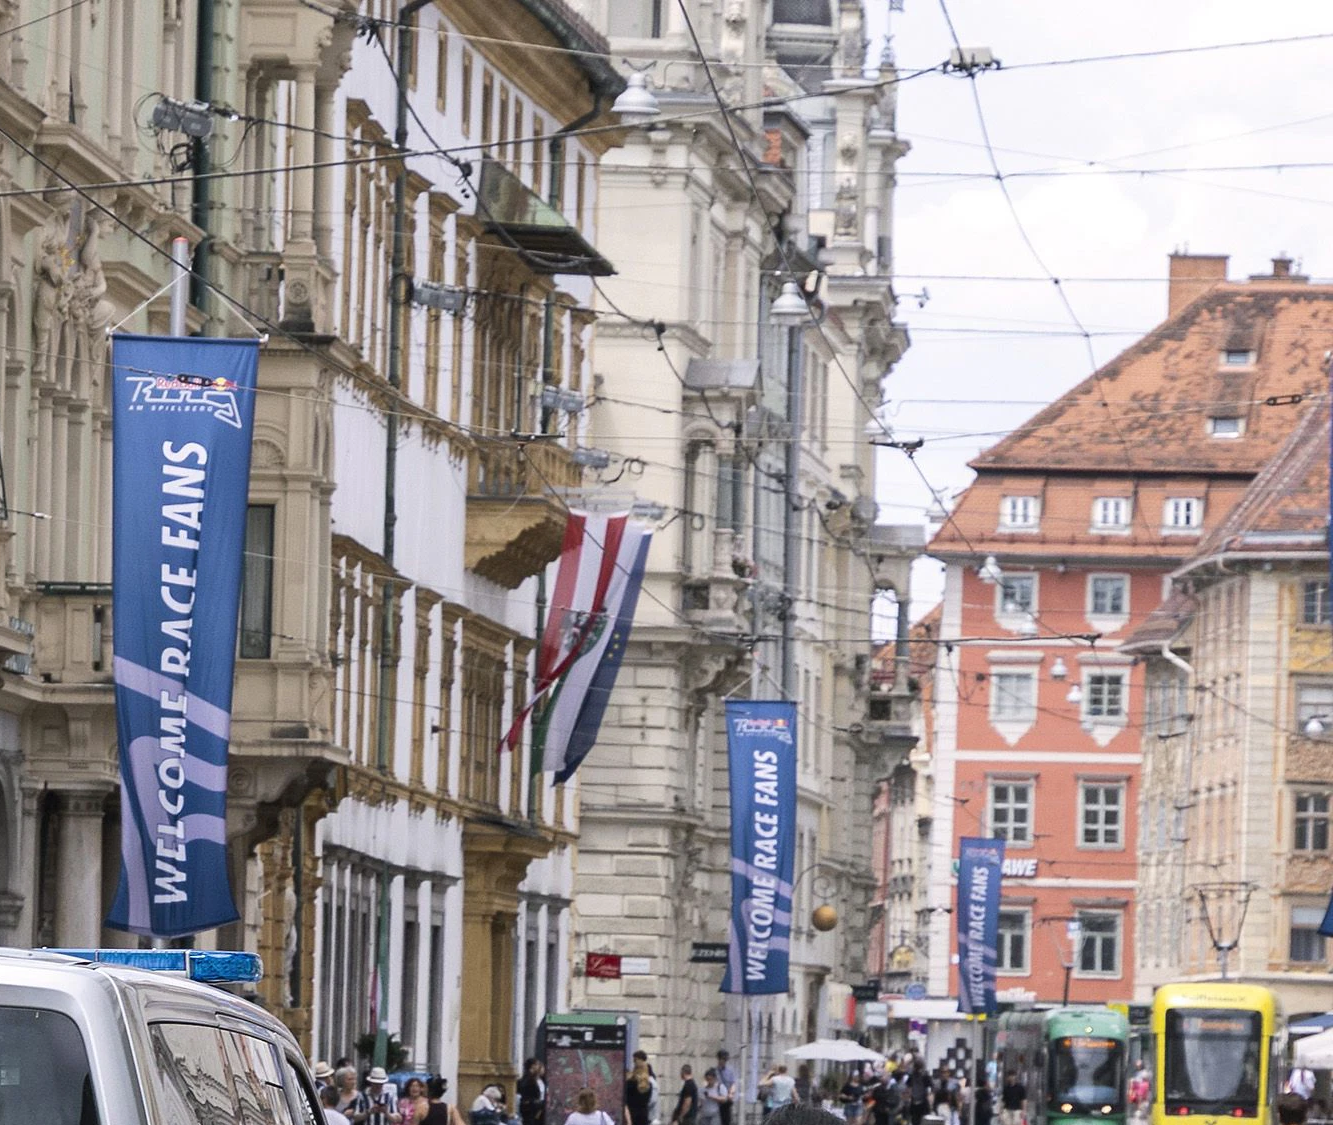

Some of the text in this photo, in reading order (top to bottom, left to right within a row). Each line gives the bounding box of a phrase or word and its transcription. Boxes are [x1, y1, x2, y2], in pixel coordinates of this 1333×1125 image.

[154, 439, 209, 905] WELCOME RACE FANS
[754, 750, 779, 806] FANS
[754, 811, 778, 870] RACE
[1001, 859, 1038, 877] AWE
[970, 866, 989, 901] FANS
[746, 875, 775, 982] WELCOME
[968, 905, 986, 940] RACE
[967, 942, 986, 1006] WELCOME
